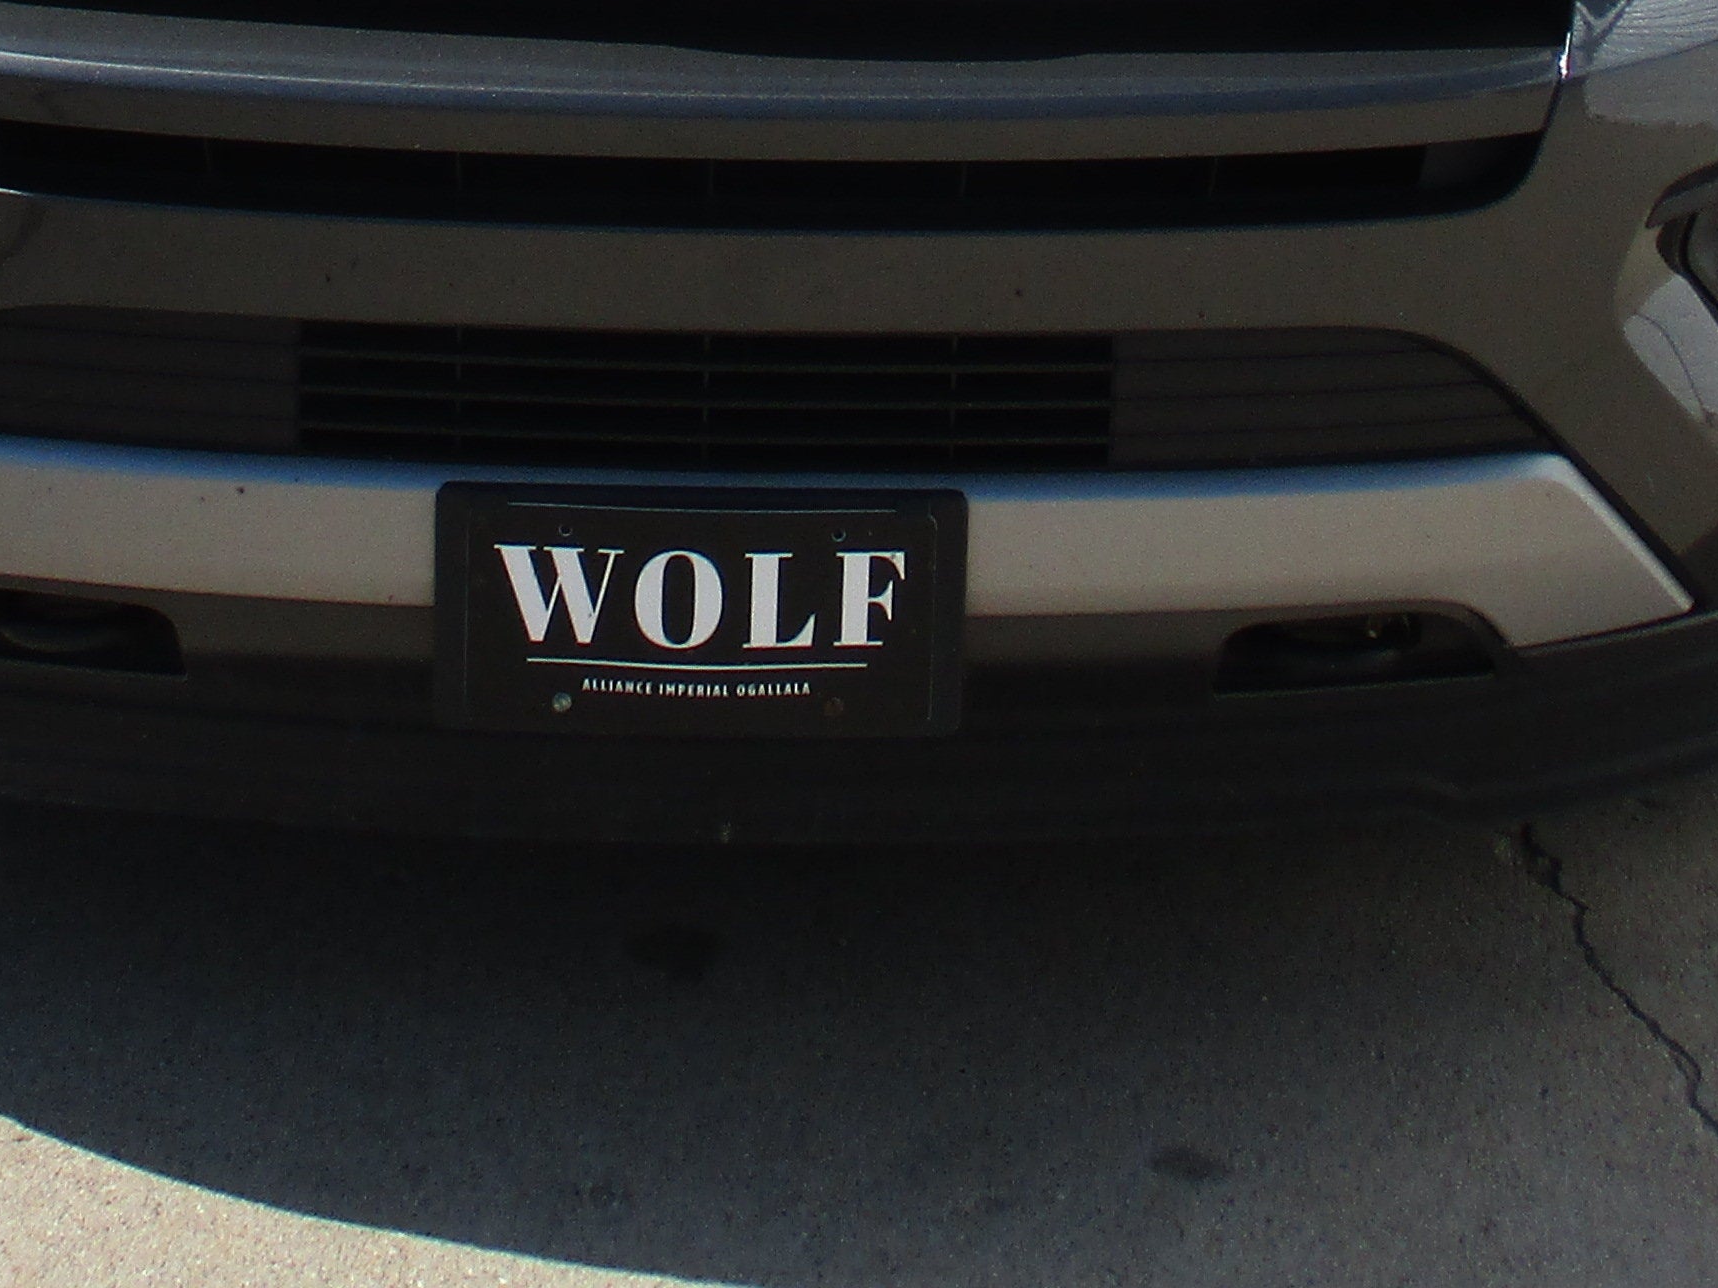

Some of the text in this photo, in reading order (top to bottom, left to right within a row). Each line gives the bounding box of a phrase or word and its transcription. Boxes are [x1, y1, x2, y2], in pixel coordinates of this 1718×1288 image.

[494, 544, 905, 650] WOLF
[582, 678, 811, 698] ALLIANCE IMPERIAL OGALLALA
